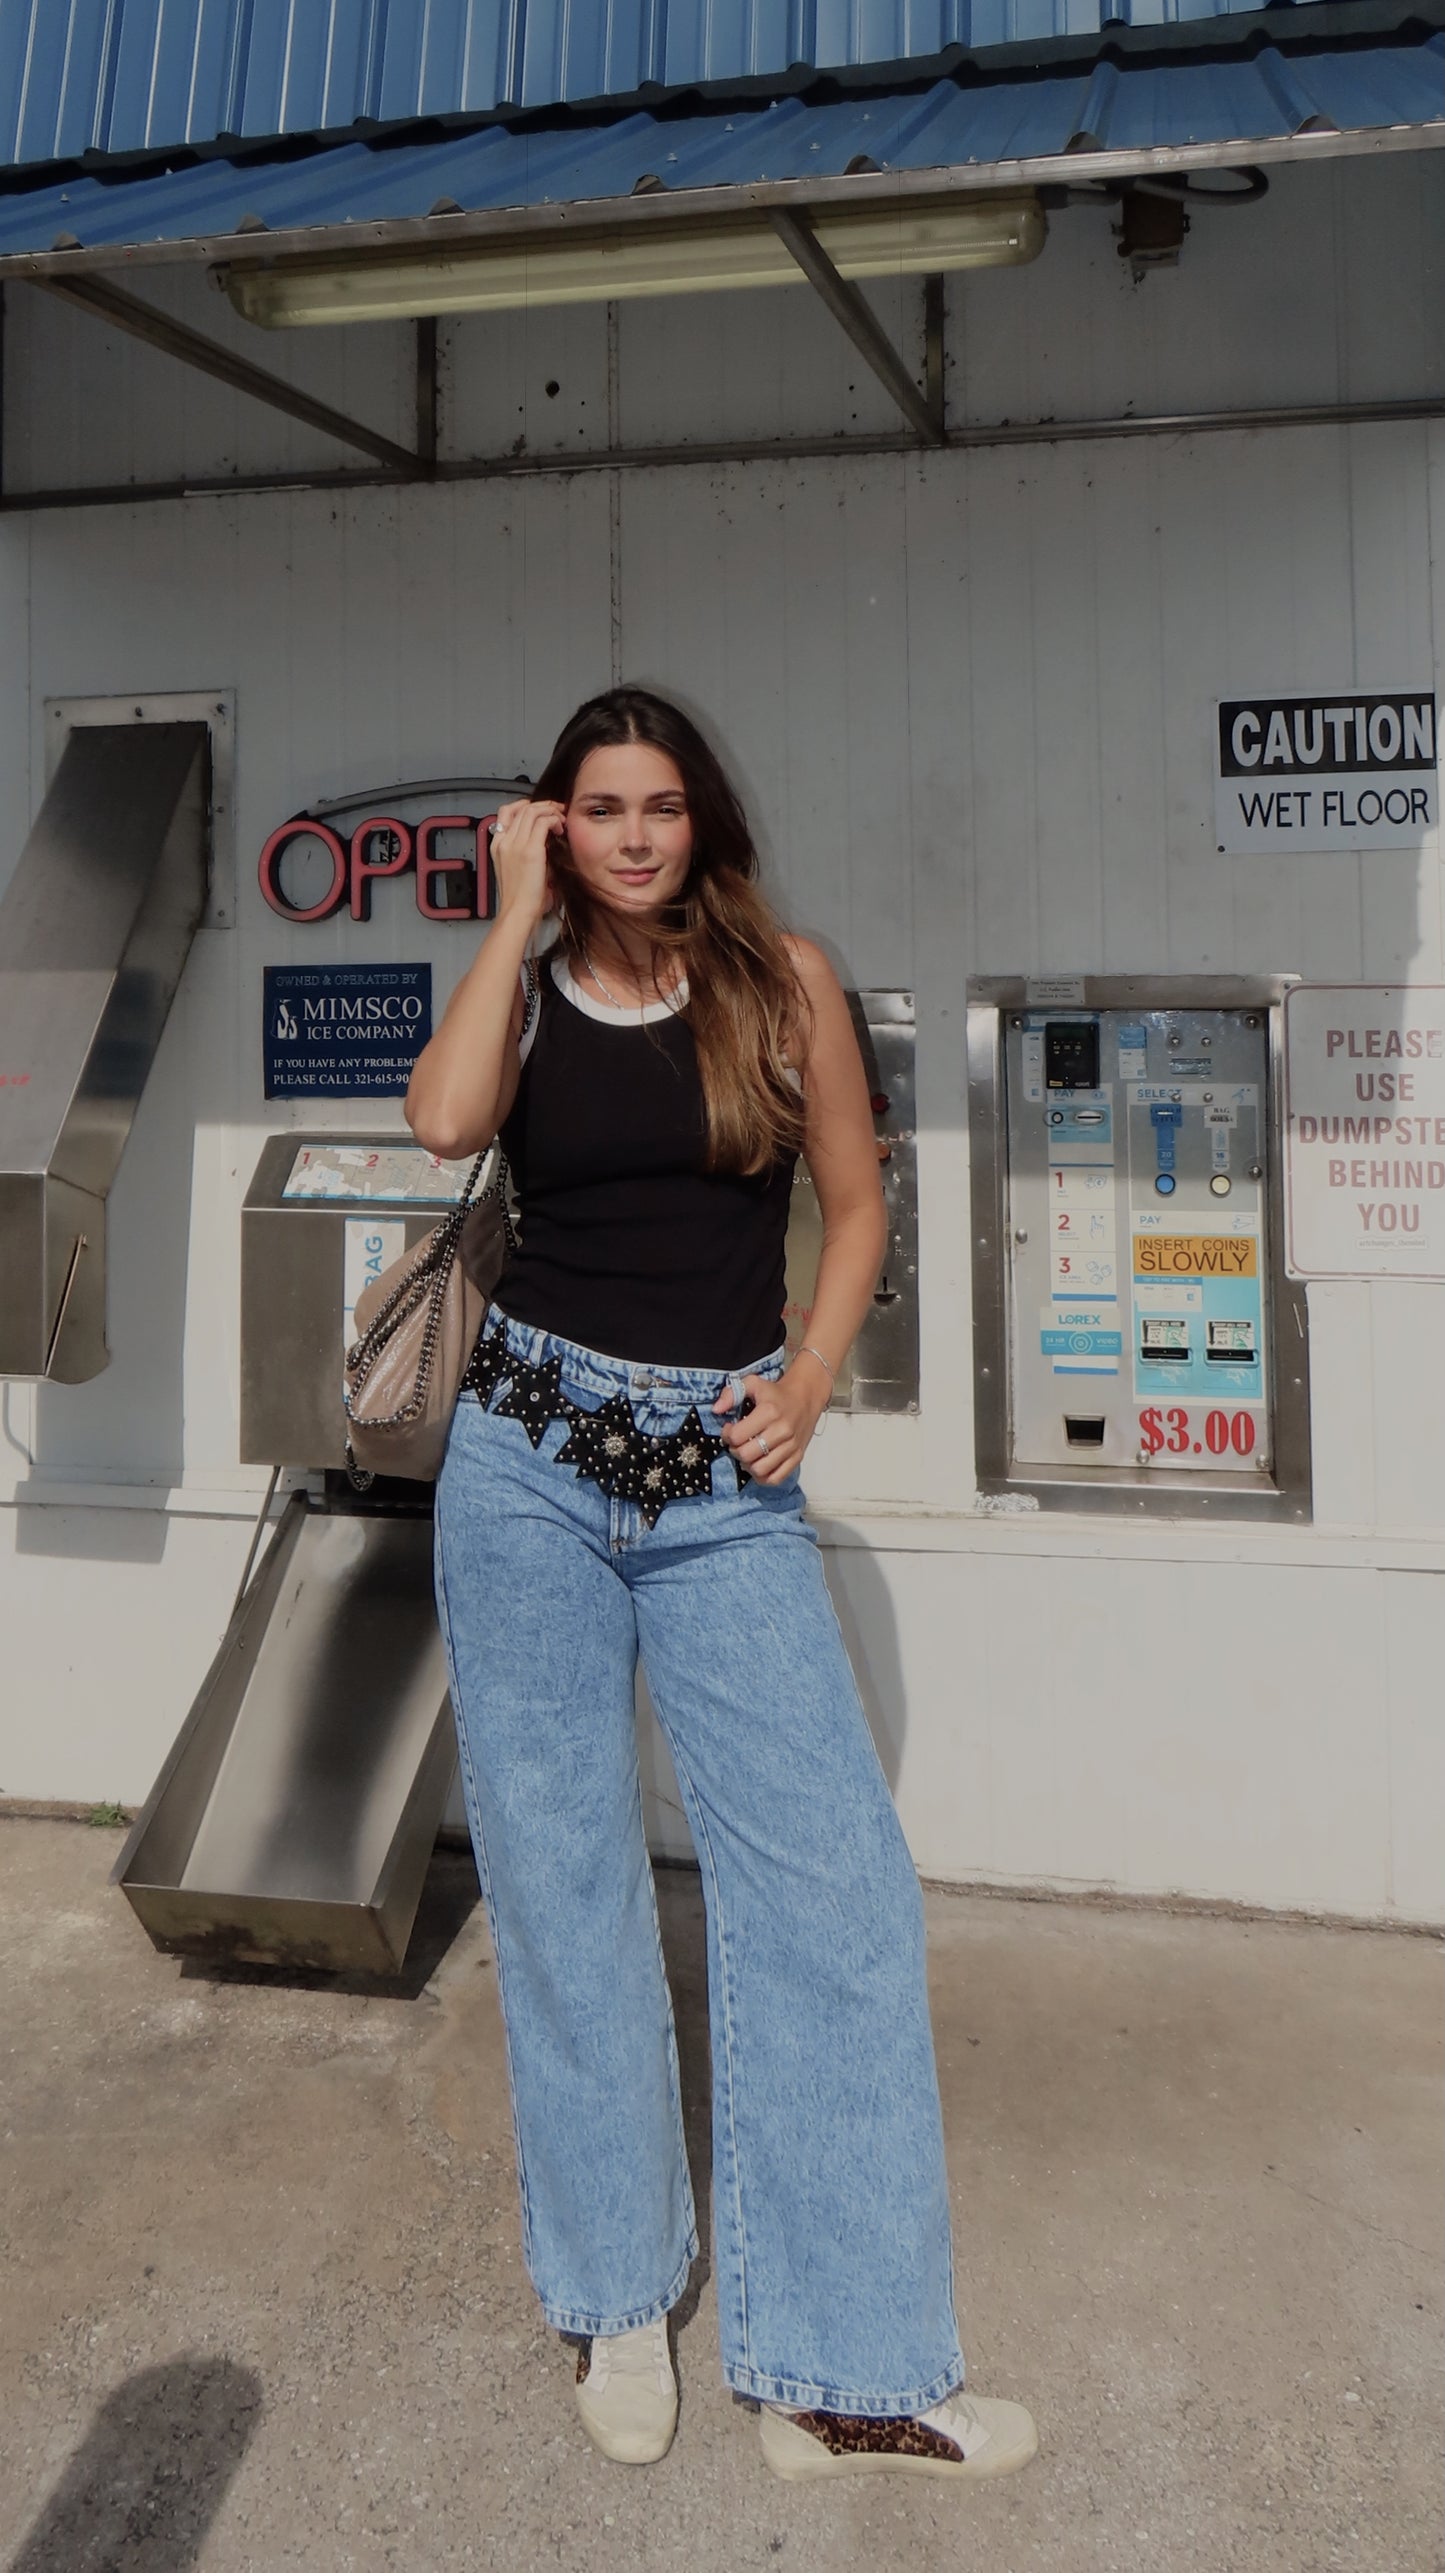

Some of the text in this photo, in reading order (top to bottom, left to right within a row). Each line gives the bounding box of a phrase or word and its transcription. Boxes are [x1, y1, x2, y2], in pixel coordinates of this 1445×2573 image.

[1231, 704, 1434, 767] CAUTION
[1238, 789, 1430, 828] WET FLOOR
[276, 972, 418, 987] OWNED & OPERATED BY
[302, 995, 423, 1021] MIMSCO
[307, 1025, 417, 1040] ICE COMPANY
[1326, 1029, 1443, 1058] PLEASE
[273, 1059, 283, 1069] IF
[286, 1059, 306, 1068] YOU
[308, 1059, 335, 1068] HAVE
[338, 1058, 361, 1068] ANY
[273, 1073, 409, 1085] PLEASE CALL 321-615-90
[1355, 1073, 1415, 1102] USE
[1054, 1088, 1075, 1098] PAY
[1137, 1088, 1183, 1098] SELECT
[1299, 1116, 1445, 1146] DUMPSTE
[303, 1152, 441, 1169] 1 2 3
[1055, 1171, 1064, 1188] 1
[1328, 1159, 1445, 1189] BEHIND
[1058, 1214, 1070, 1230] 2
[1139, 1215, 1162, 1225] PAY
[1357, 1203, 1420, 1233] YOU
[1138, 1239, 1250, 1251] INSERT COINS
[1059, 1257, 1071, 1273] 3
[1139, 1251, 1249, 1272] SLOWLY
[1058, 1314, 1101, 1325] LOREX
[1139, 1406, 1256, 1456] $3.00
